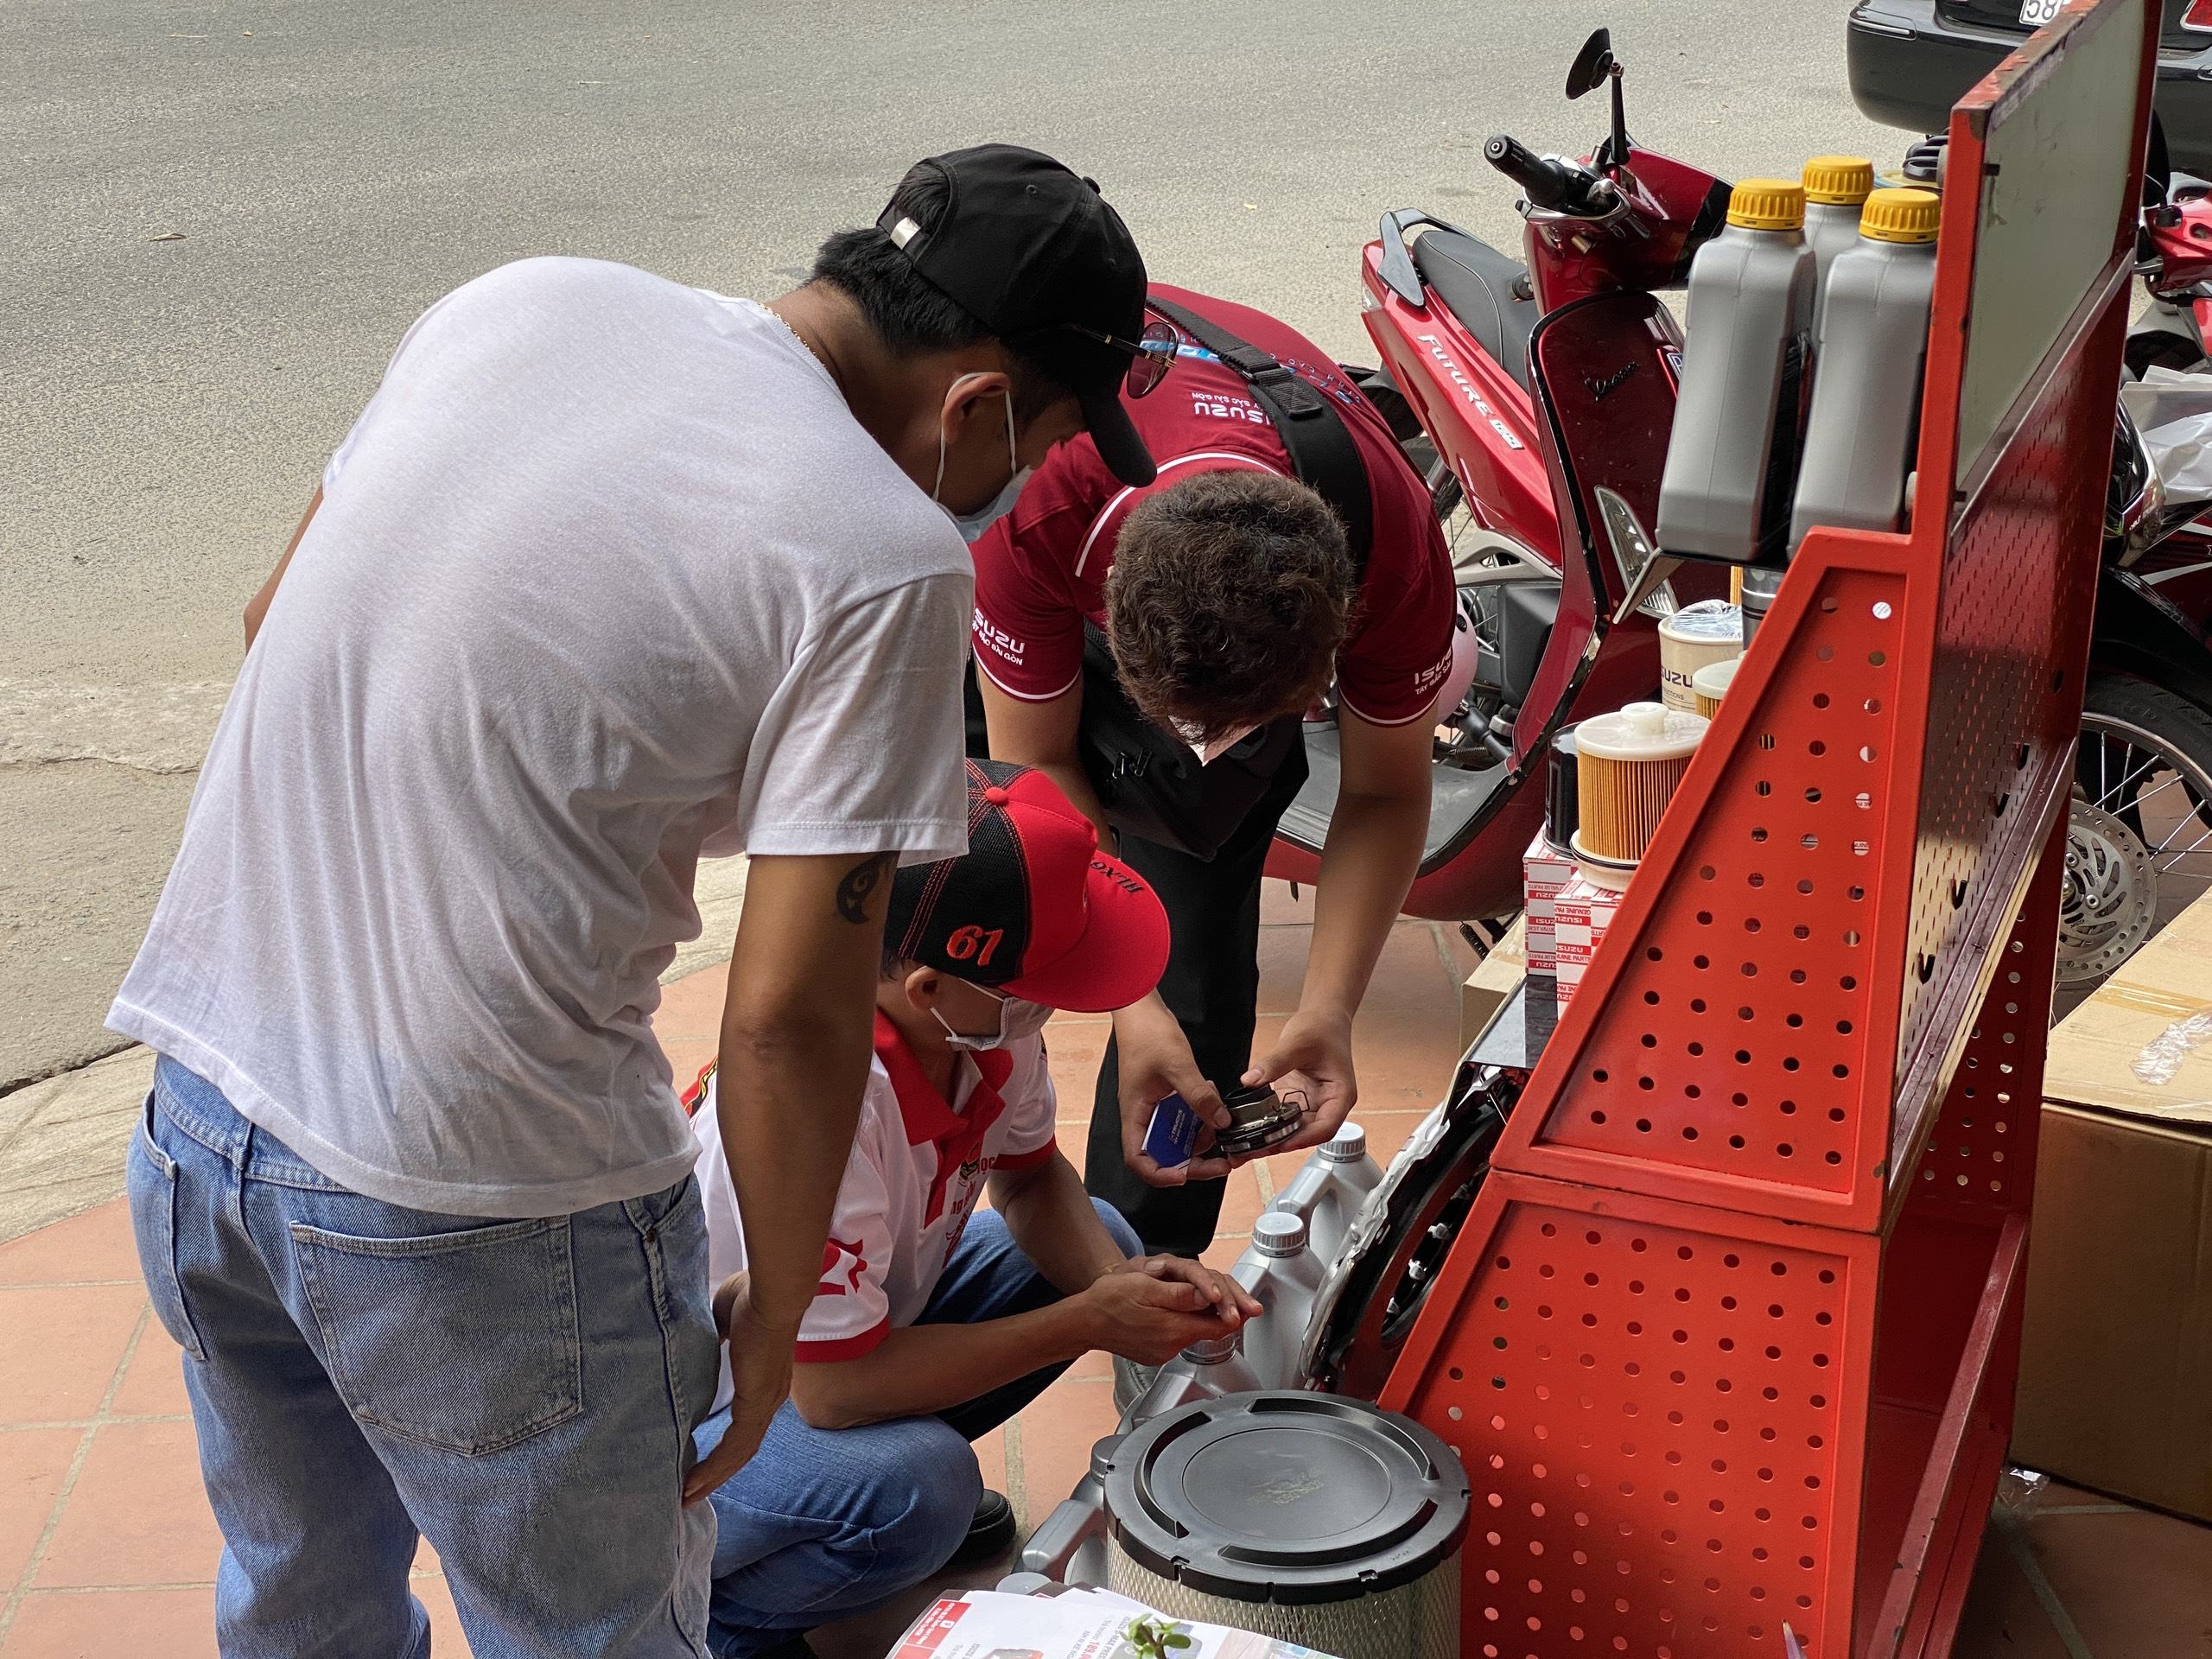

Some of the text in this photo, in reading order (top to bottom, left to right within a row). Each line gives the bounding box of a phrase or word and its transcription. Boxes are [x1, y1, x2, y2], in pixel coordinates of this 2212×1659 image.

[2026, 0, 2067, 20] 58
[1417, 334, 1495, 418] FUTURE
[1194, 402, 1270, 426] ISUZU
[975, 607, 1025, 654] SUZU
[1567, 907, 1592, 916] GENUINE
[947, 925, 1004, 966] 61
